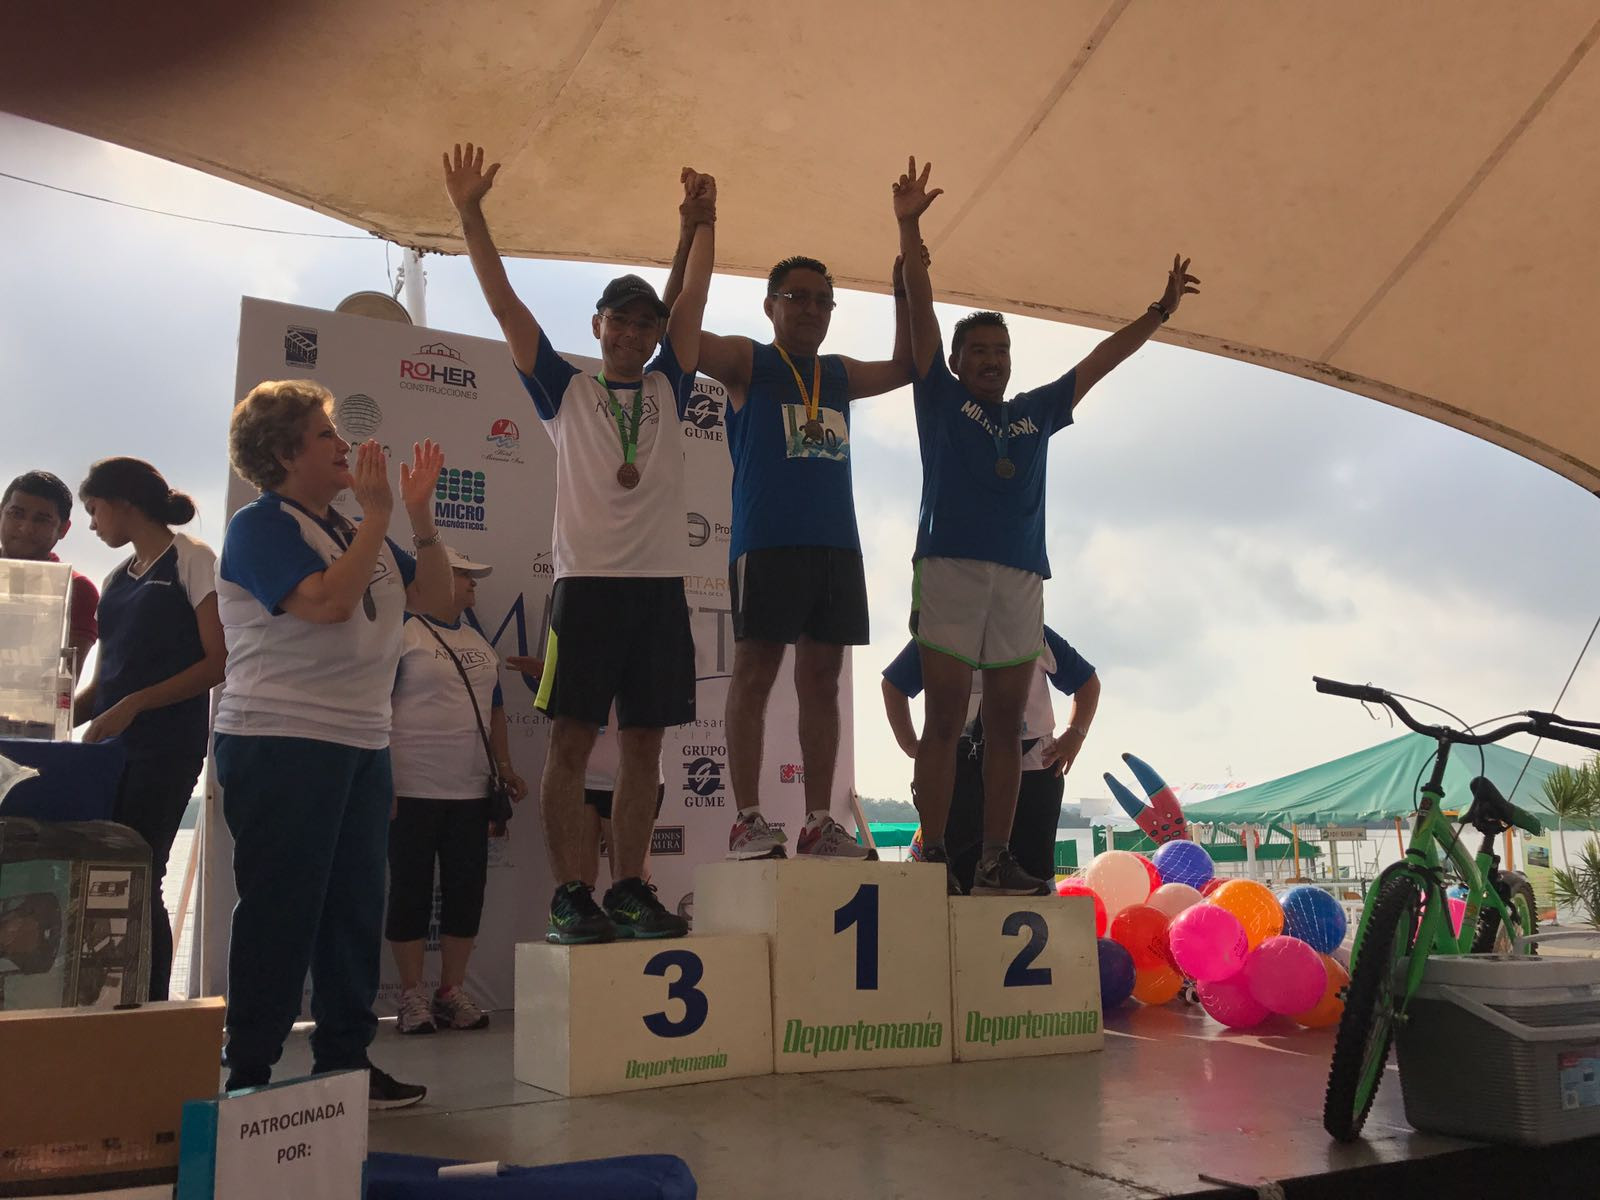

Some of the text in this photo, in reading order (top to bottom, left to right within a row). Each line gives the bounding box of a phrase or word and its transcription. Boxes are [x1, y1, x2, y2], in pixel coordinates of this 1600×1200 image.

[400, 359, 477, 389] ROHER
[400, 381, 478, 400] CONSTRUCCIONES
[693, 382, 725, 396] RUPO
[684, 427, 723, 441] GUME
[435, 502, 485, 522] MICRO
[533, 563, 554, 574] ORY
[682, 744, 726, 757] GRUPO
[684, 796, 726, 808] GUME
[834, 883, 879, 990] 1
[1001, 911, 1053, 987] 2
[642, 949, 708, 1038] 3
[240, 1101, 346, 1140] PATROCINADA
[277, 1142, 312, 1164] POR:
